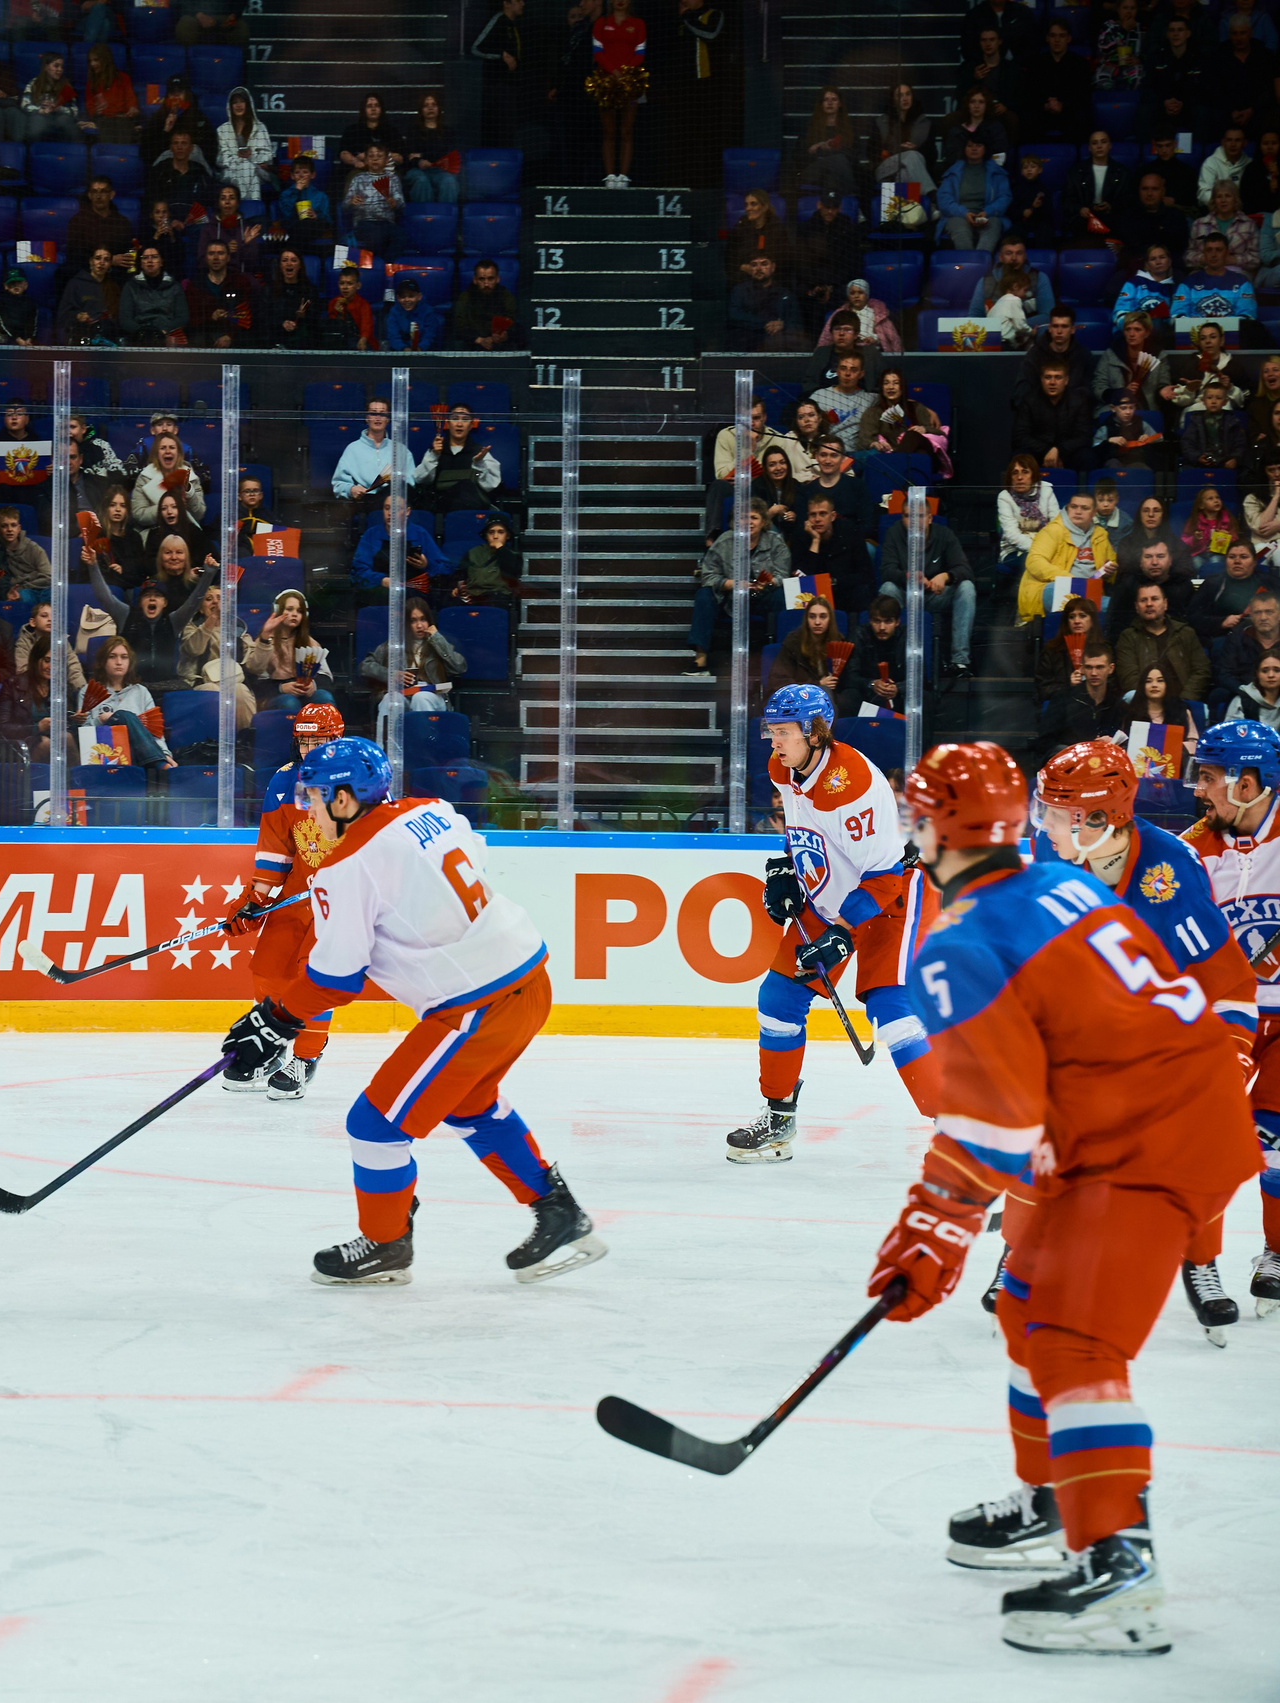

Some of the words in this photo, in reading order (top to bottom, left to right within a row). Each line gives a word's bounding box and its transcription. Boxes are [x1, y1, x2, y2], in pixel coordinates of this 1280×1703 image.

[248, 44, 272, 61] 17
[260, 93, 285, 110] 16
[544, 195, 569, 215] 14
[656, 195, 682, 216] 14
[537, 249, 564, 270] 13
[658, 249, 686, 270] 13
[534, 307, 562, 328] 12
[658, 307, 686, 329] 12
[535, 364, 557, 386] 11
[661, 366, 684, 389] 11
[329, 771, 352, 781] CCM
[844, 807, 876, 842] 97
[990, 821, 1006, 843] 5
[787, 828, 824, 853] СХЛ
[441, 846, 490, 924] 6
[313, 888, 332, 921] 6
[1175, 916, 1211, 957] 11
[1085, 920, 1207, 1024] 5
[921, 960, 954, 1019] 5
